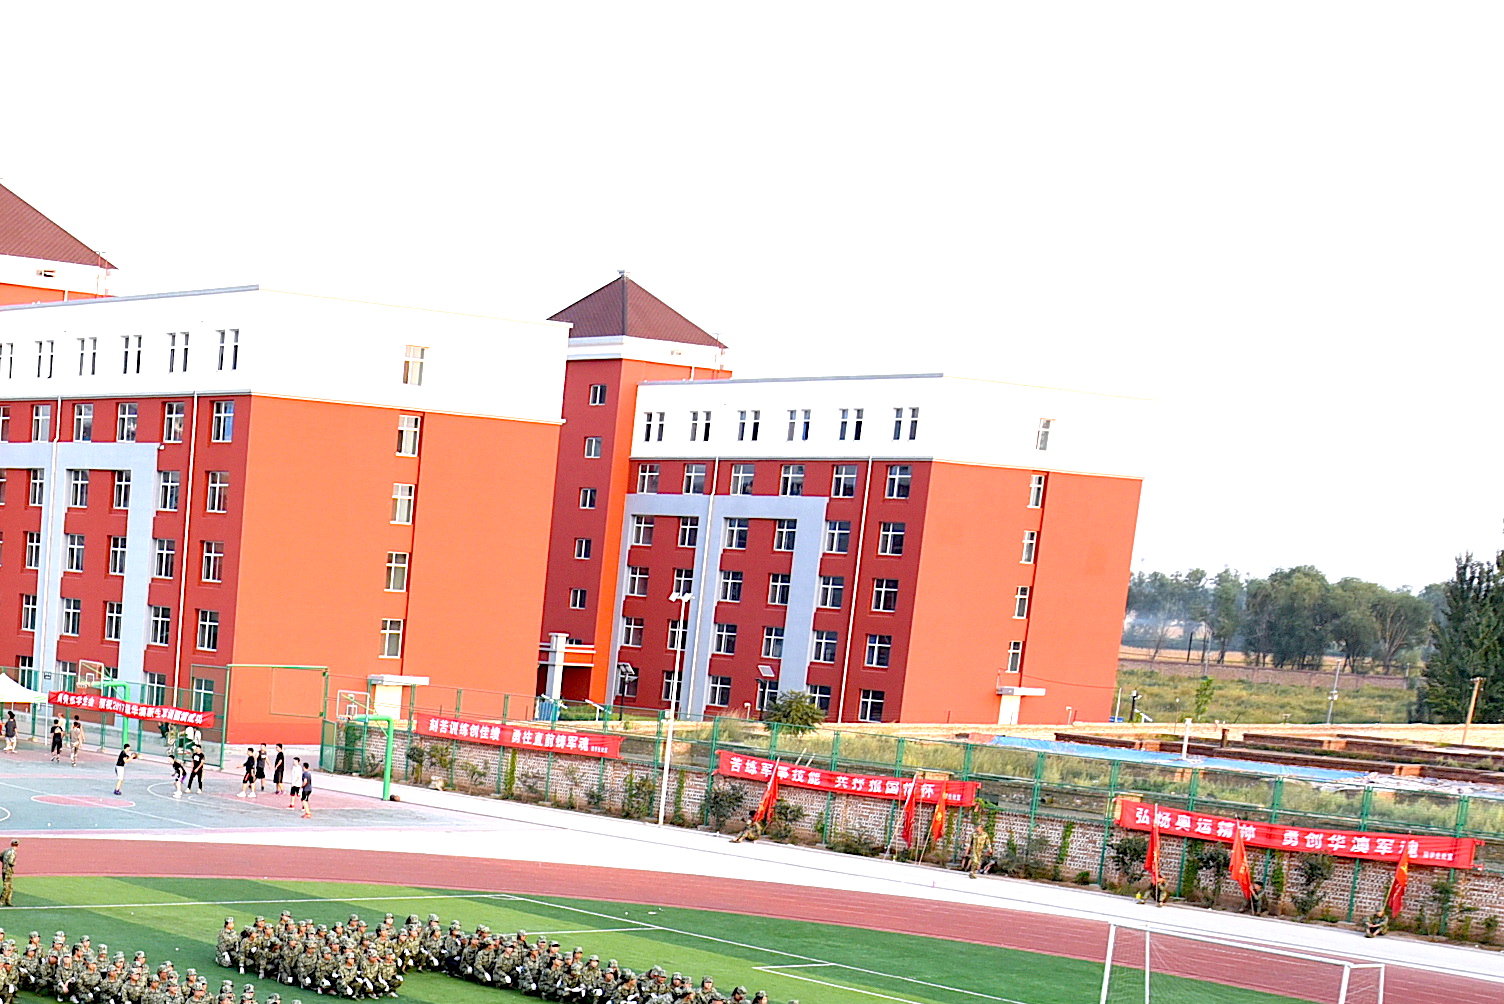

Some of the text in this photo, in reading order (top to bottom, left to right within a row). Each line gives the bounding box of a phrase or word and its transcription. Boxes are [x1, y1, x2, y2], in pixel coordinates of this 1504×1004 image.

[429, 718, 590, 752] 刻苦训练创佳绩 勇往直前铸军魂
[730, 756, 821, 786] 苦练军事技能
[1135, 807, 1256, 841] 弘扬奥运精神
[1282, 829, 1419, 860] 勇创华澳军魂
